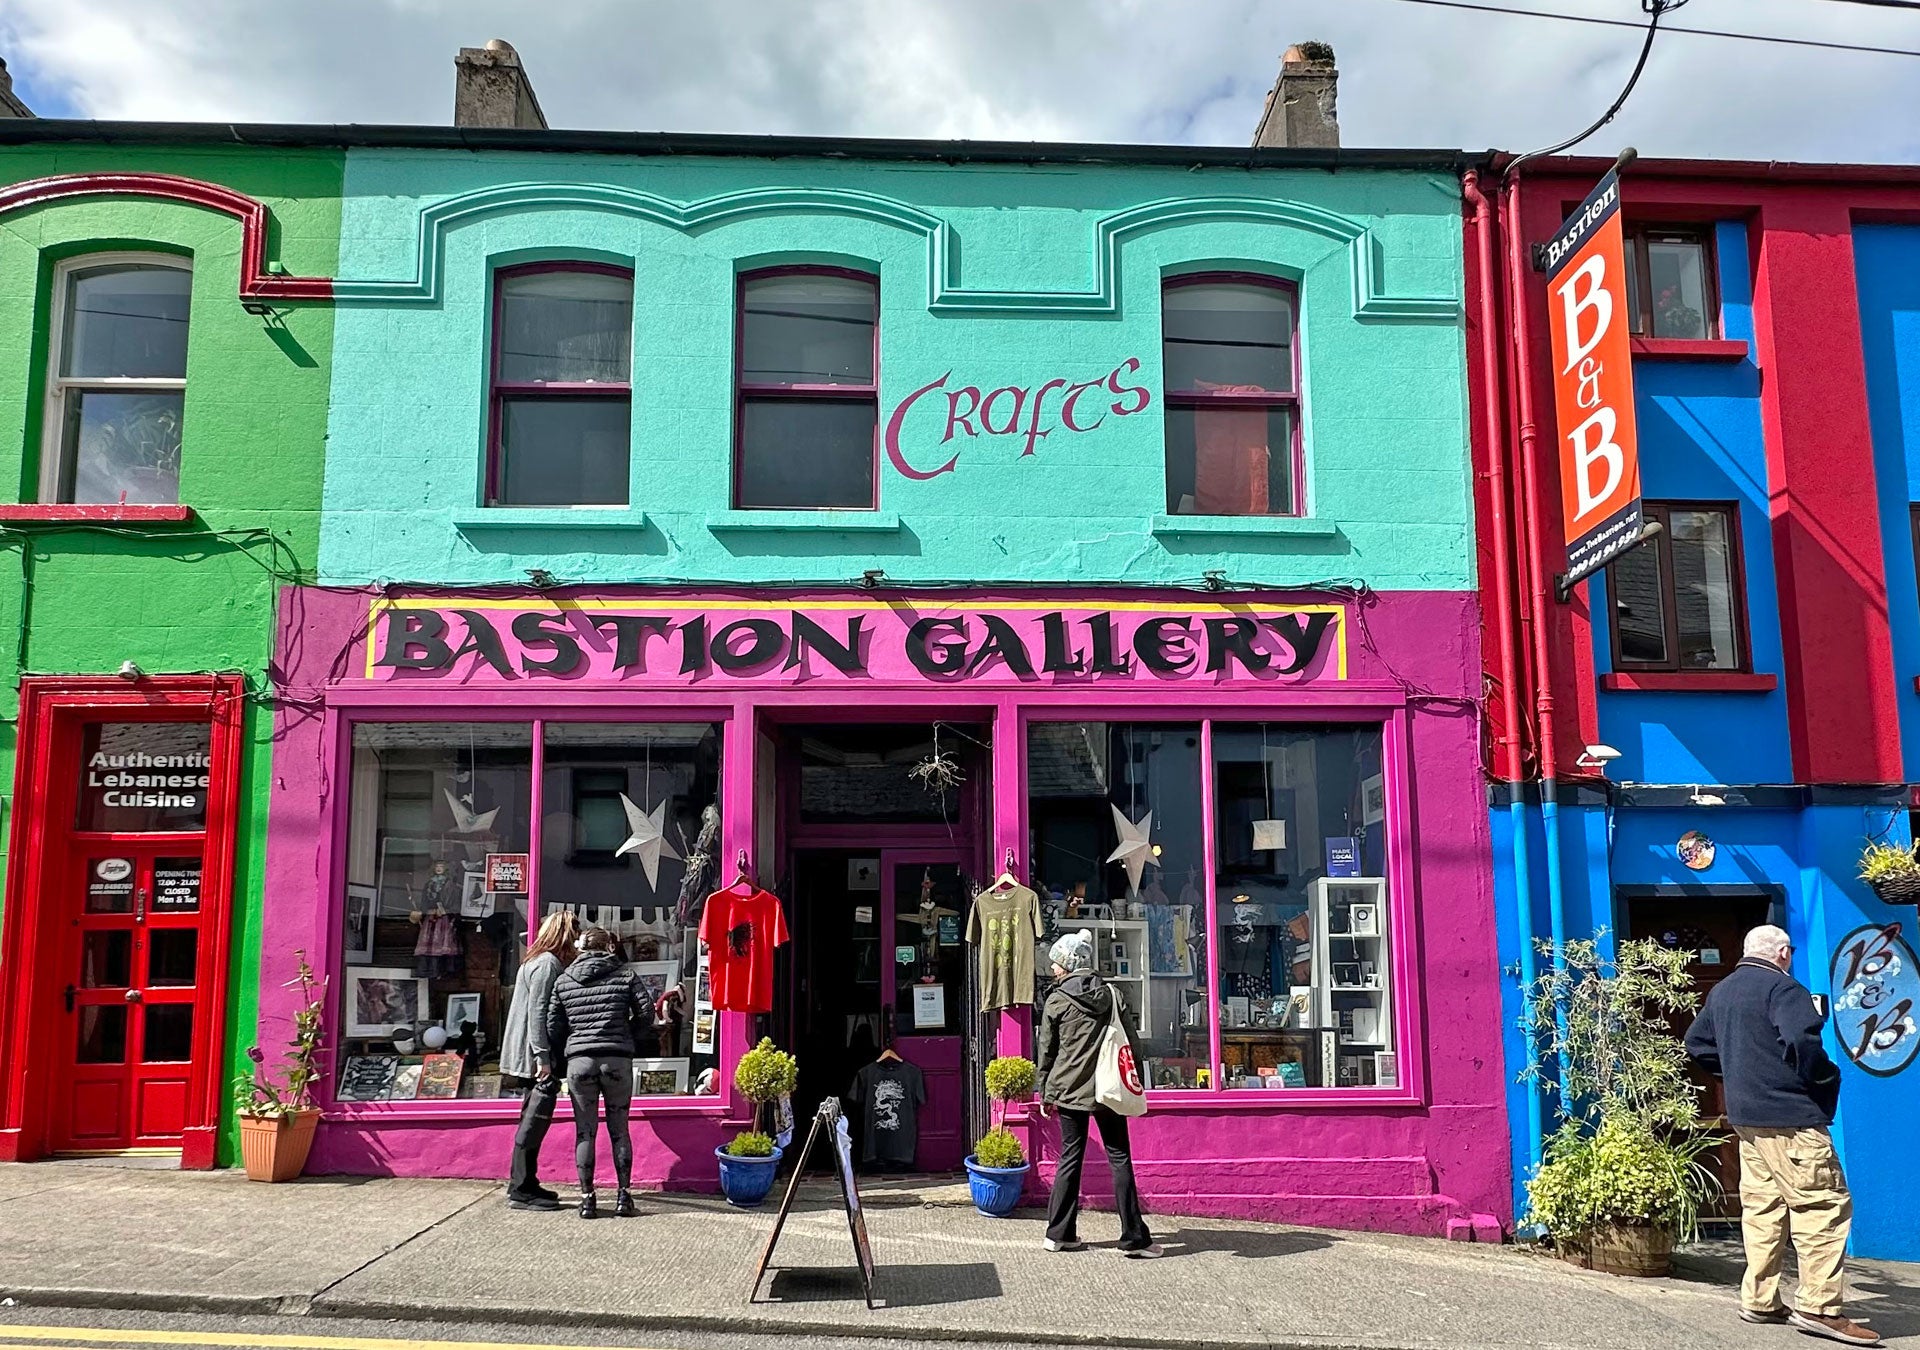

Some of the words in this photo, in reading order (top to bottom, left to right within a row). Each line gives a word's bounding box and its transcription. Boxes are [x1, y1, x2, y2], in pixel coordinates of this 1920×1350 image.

[1557, 254, 1613, 376] B
[1577, 356, 1603, 408] &
[1567, 406, 1624, 523] B
[371, 608, 868, 680] BASTION
[904, 610, 1340, 682] GALLERY
[88, 751, 211, 768] Authentic
[88, 771, 210, 788] Lebanese
[103, 790, 196, 808] Cuisine
[155, 870, 186, 878] OPENING
[491, 867, 522, 875] DRAMA
[157, 895, 174, 904] Mon
[175, 895, 182, 903] &
[184, 895, 198, 903] Tue
[164, 887, 191, 895] CLOSED
[1842, 922, 1902, 989] B
[1860, 981, 1894, 1010] &
[1852, 999, 1913, 1062] B
